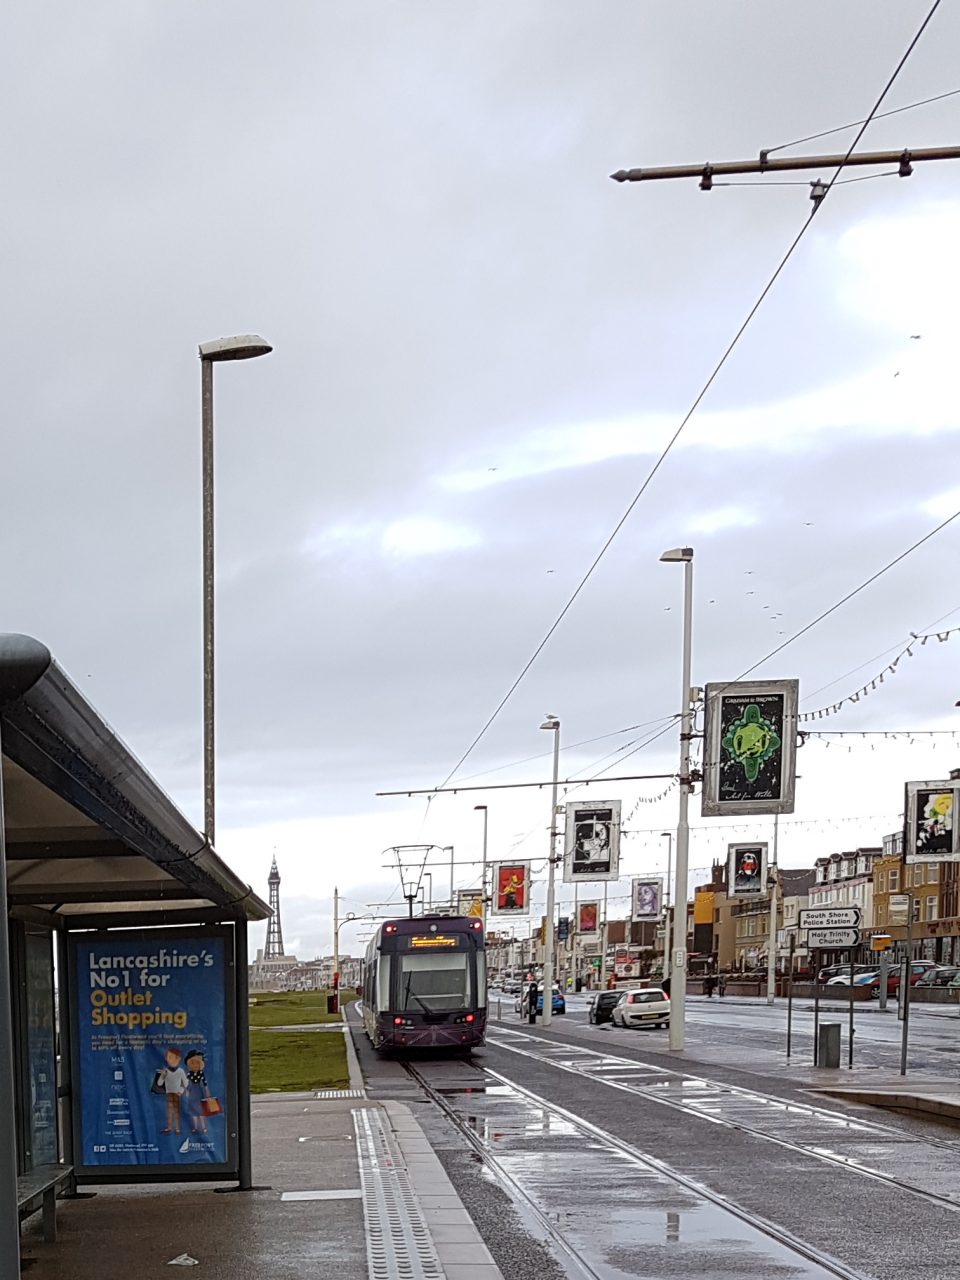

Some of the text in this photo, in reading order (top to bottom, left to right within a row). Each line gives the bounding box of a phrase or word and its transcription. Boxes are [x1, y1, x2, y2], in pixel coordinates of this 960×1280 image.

[89, 949, 214, 969] Lancashire's
[140, 968, 170, 987] for
[90, 988, 152, 1007] Outlet
[91, 1006, 187, 1029] Shopping
